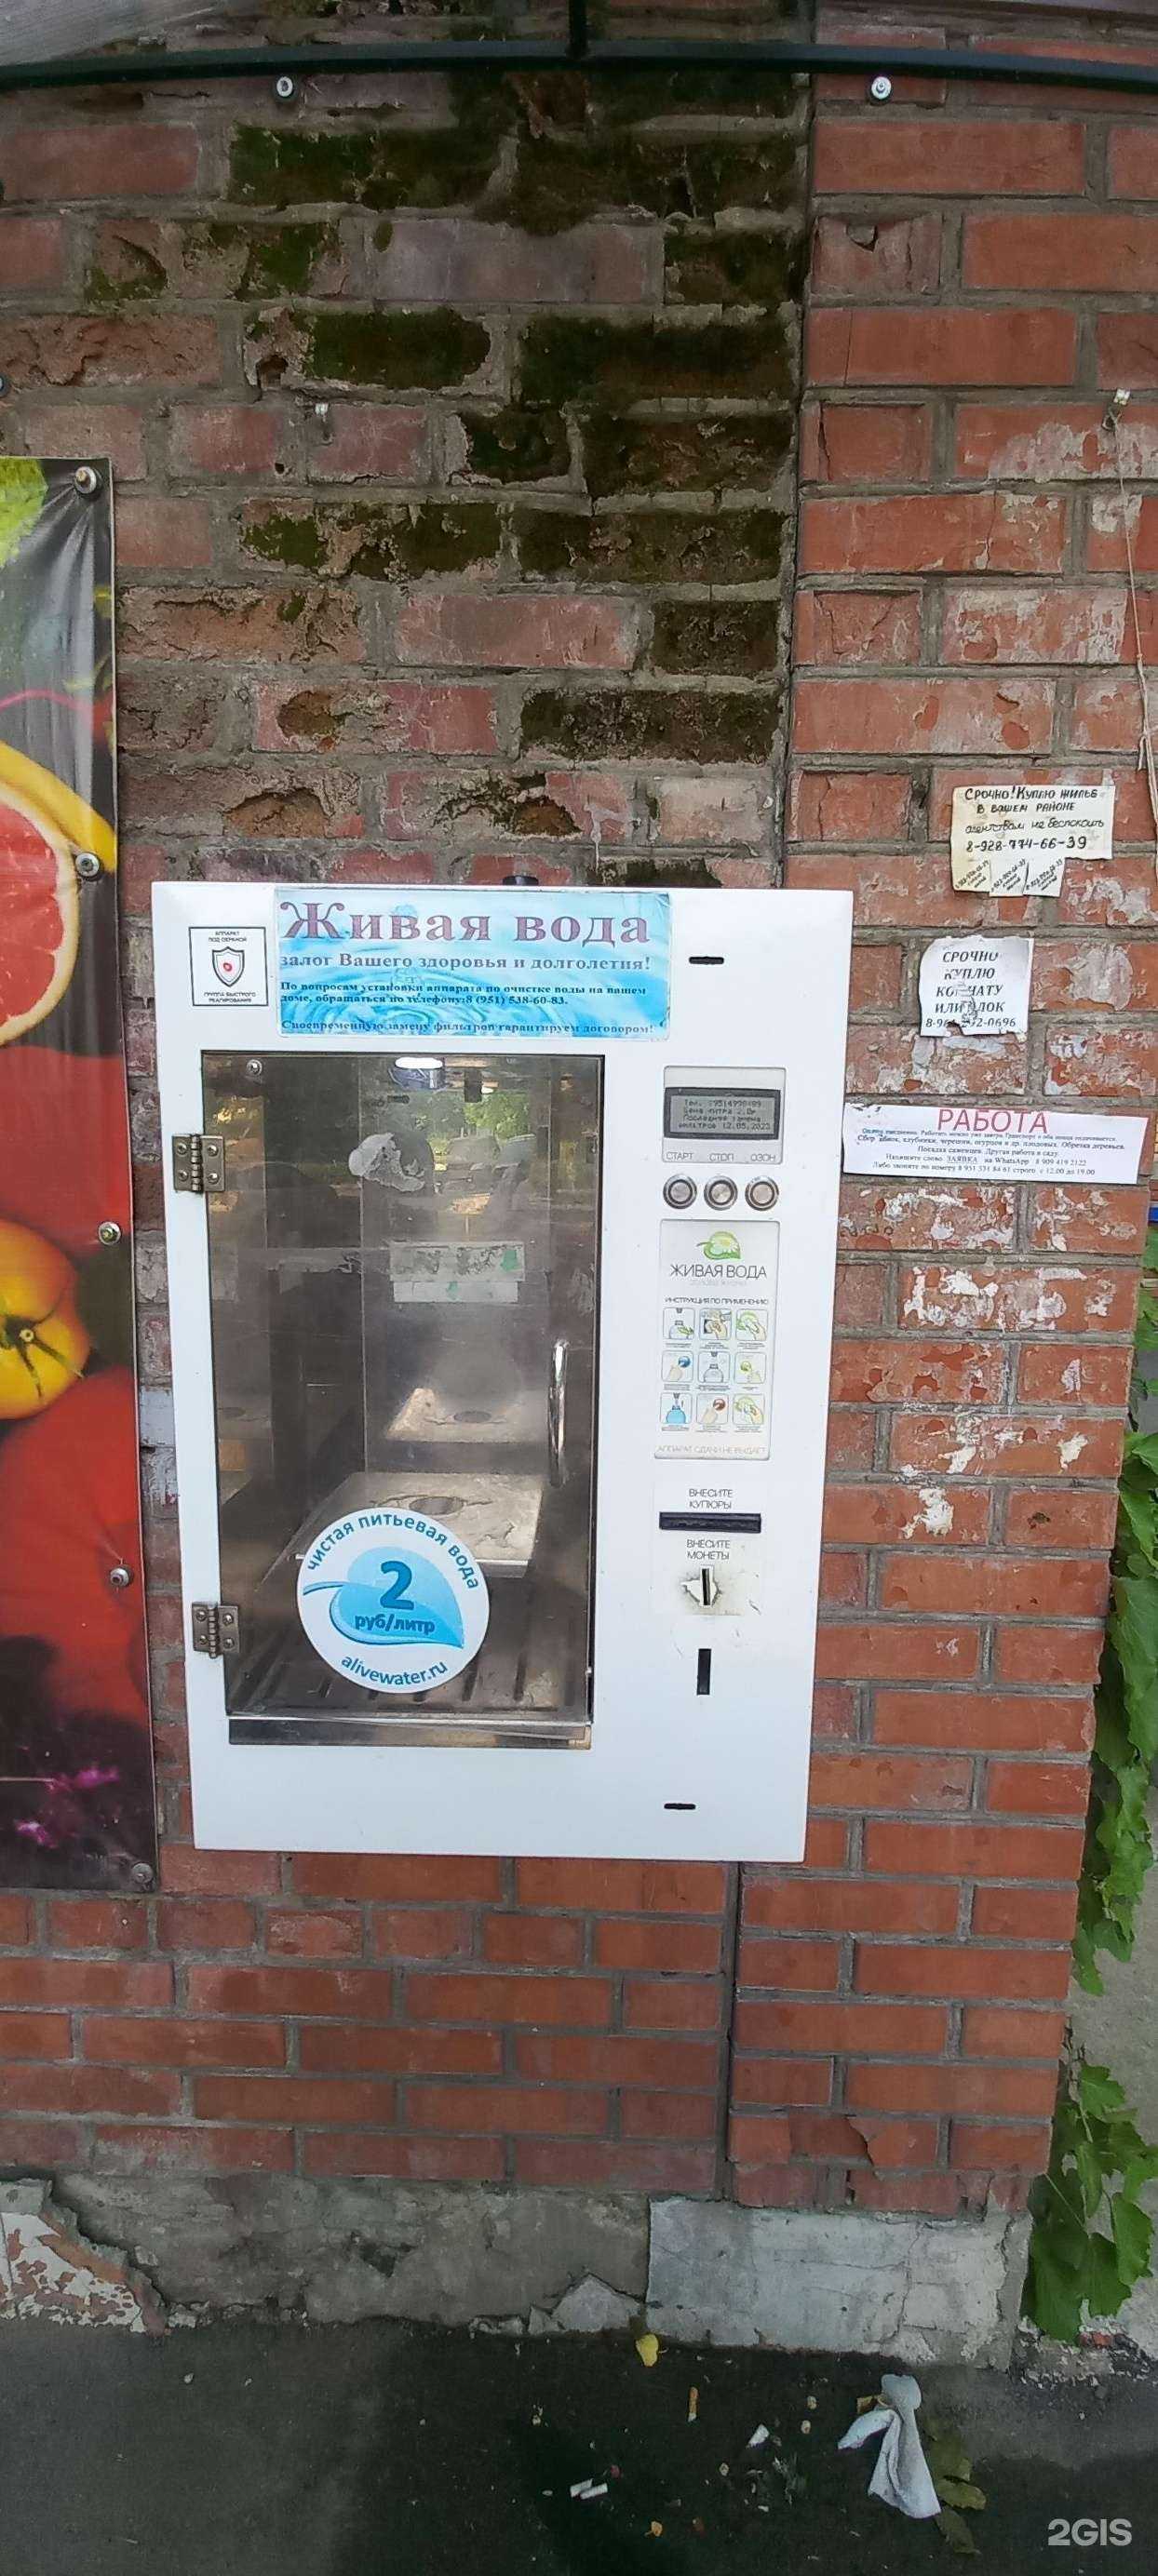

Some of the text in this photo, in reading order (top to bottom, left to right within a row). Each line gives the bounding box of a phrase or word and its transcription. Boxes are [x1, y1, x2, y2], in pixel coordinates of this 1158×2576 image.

[966, 837, 1087, 852] 8-928-774-66-39
[279, 901, 651, 947] Живая вода
[281, 953, 651, 972] залог Вашего здоровья и долголетия!
[942, 950, 999, 962] СРОЧНО
[281, 982, 297, 991] По
[302, 983, 358, 993] вопросам
[361, 984, 423, 993] установки
[426, 986, 482, 995] аппарата
[555, 986, 586, 995] воды
[607, 986, 647, 995] вашем
[280, 995, 312, 1004] доме,
[316, 995, 386, 1004] обращаться
[475, 995, 505, 1006] (951)
[937, 1107, 1048, 1134] РАБОТА
[667, 1151, 694, 1161] СТАРТ
[709, 1153, 734, 1161] СТОП
[670, 1264, 767, 1279] ЖИВАЯ ВОДА
[689, 1489, 734, 1497] ВНЕСИТЕ
[689, 1500, 732, 1509] КУПЮРЫ
[687, 1539, 731, 1549] ВНЕСИТЕ
[308, 1514, 479, 1590] чистая питьевая вода
[687, 1550, 730, 1560] МОНЕТЫ
[380, 1560, 414, 1611] 2
[355, 1614, 436, 1635] руб/литр
[341, 1655, 449, 1685] alivewater.ru
